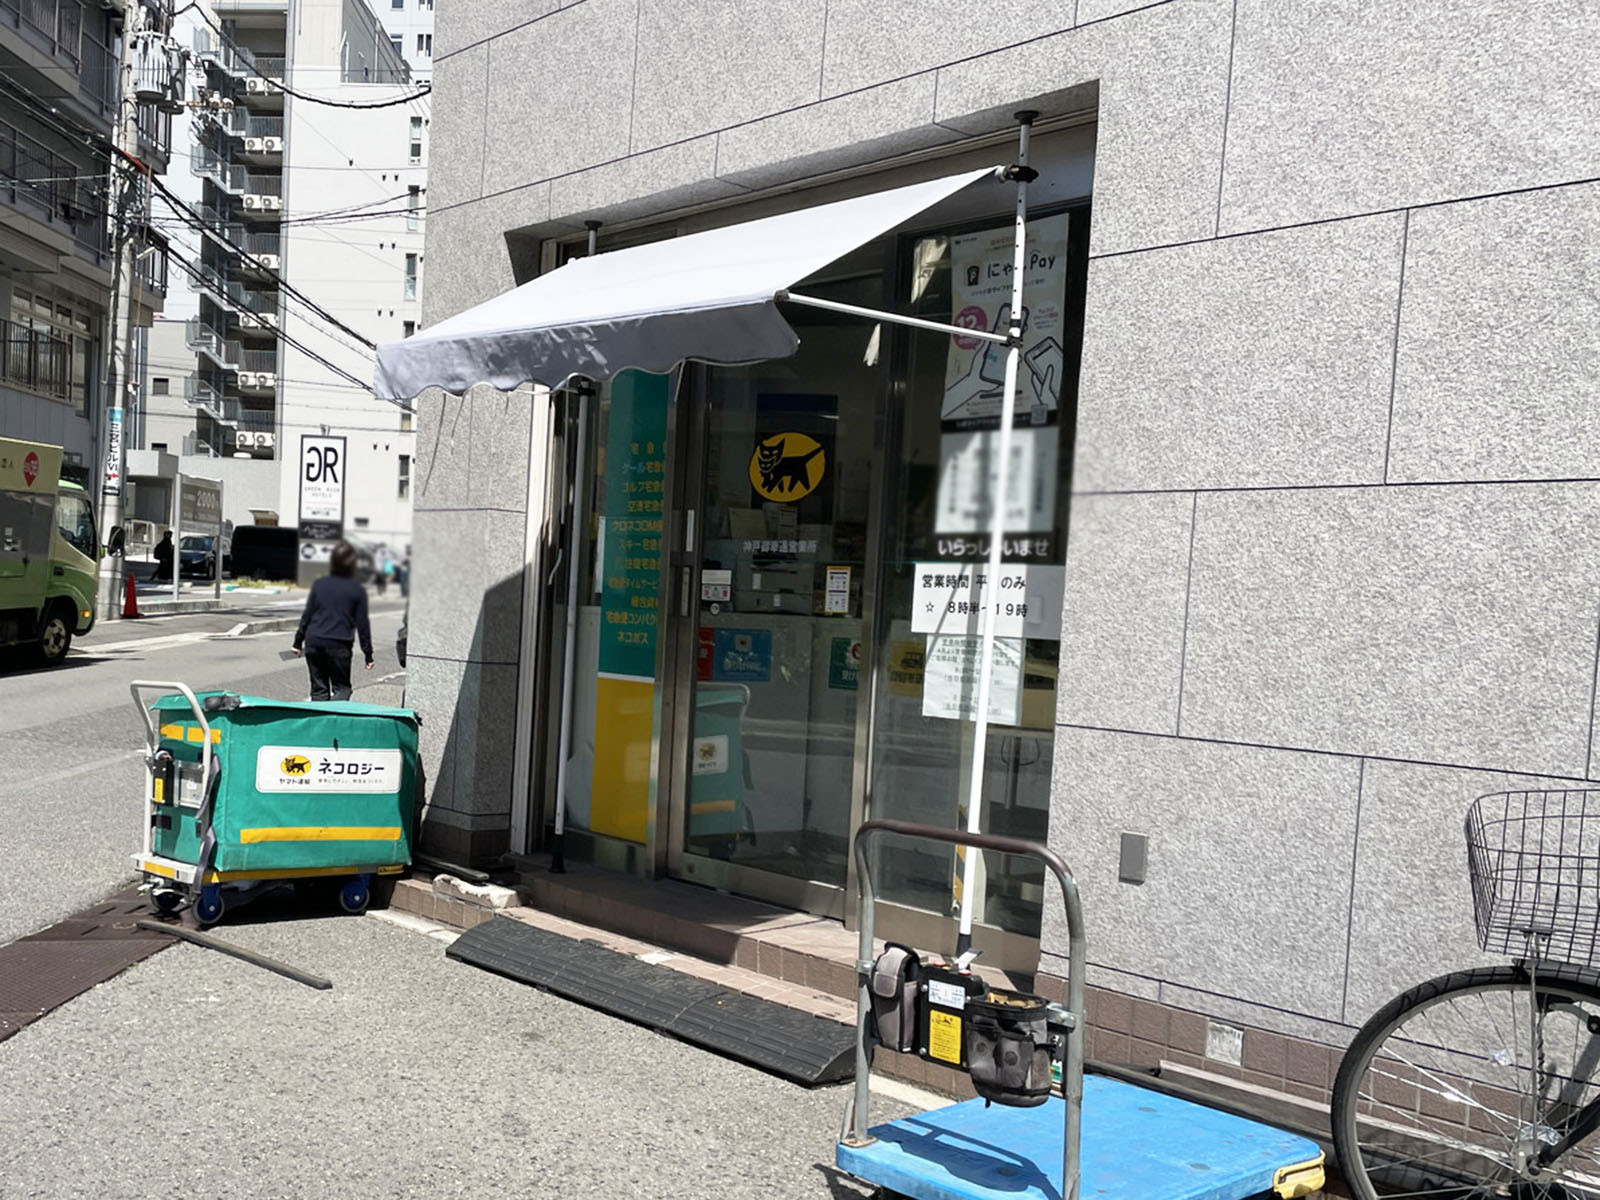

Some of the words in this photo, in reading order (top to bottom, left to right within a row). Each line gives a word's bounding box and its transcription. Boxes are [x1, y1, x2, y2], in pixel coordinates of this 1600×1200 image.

[988, 253, 1056, 279] にゃPay
[938, 539, 1050, 557] いらっしいませ
[922, 574, 969, 589] 営業時間
[976, 574, 1027, 590] 平のみ
[318, 757, 385, 775] ネコロジー
